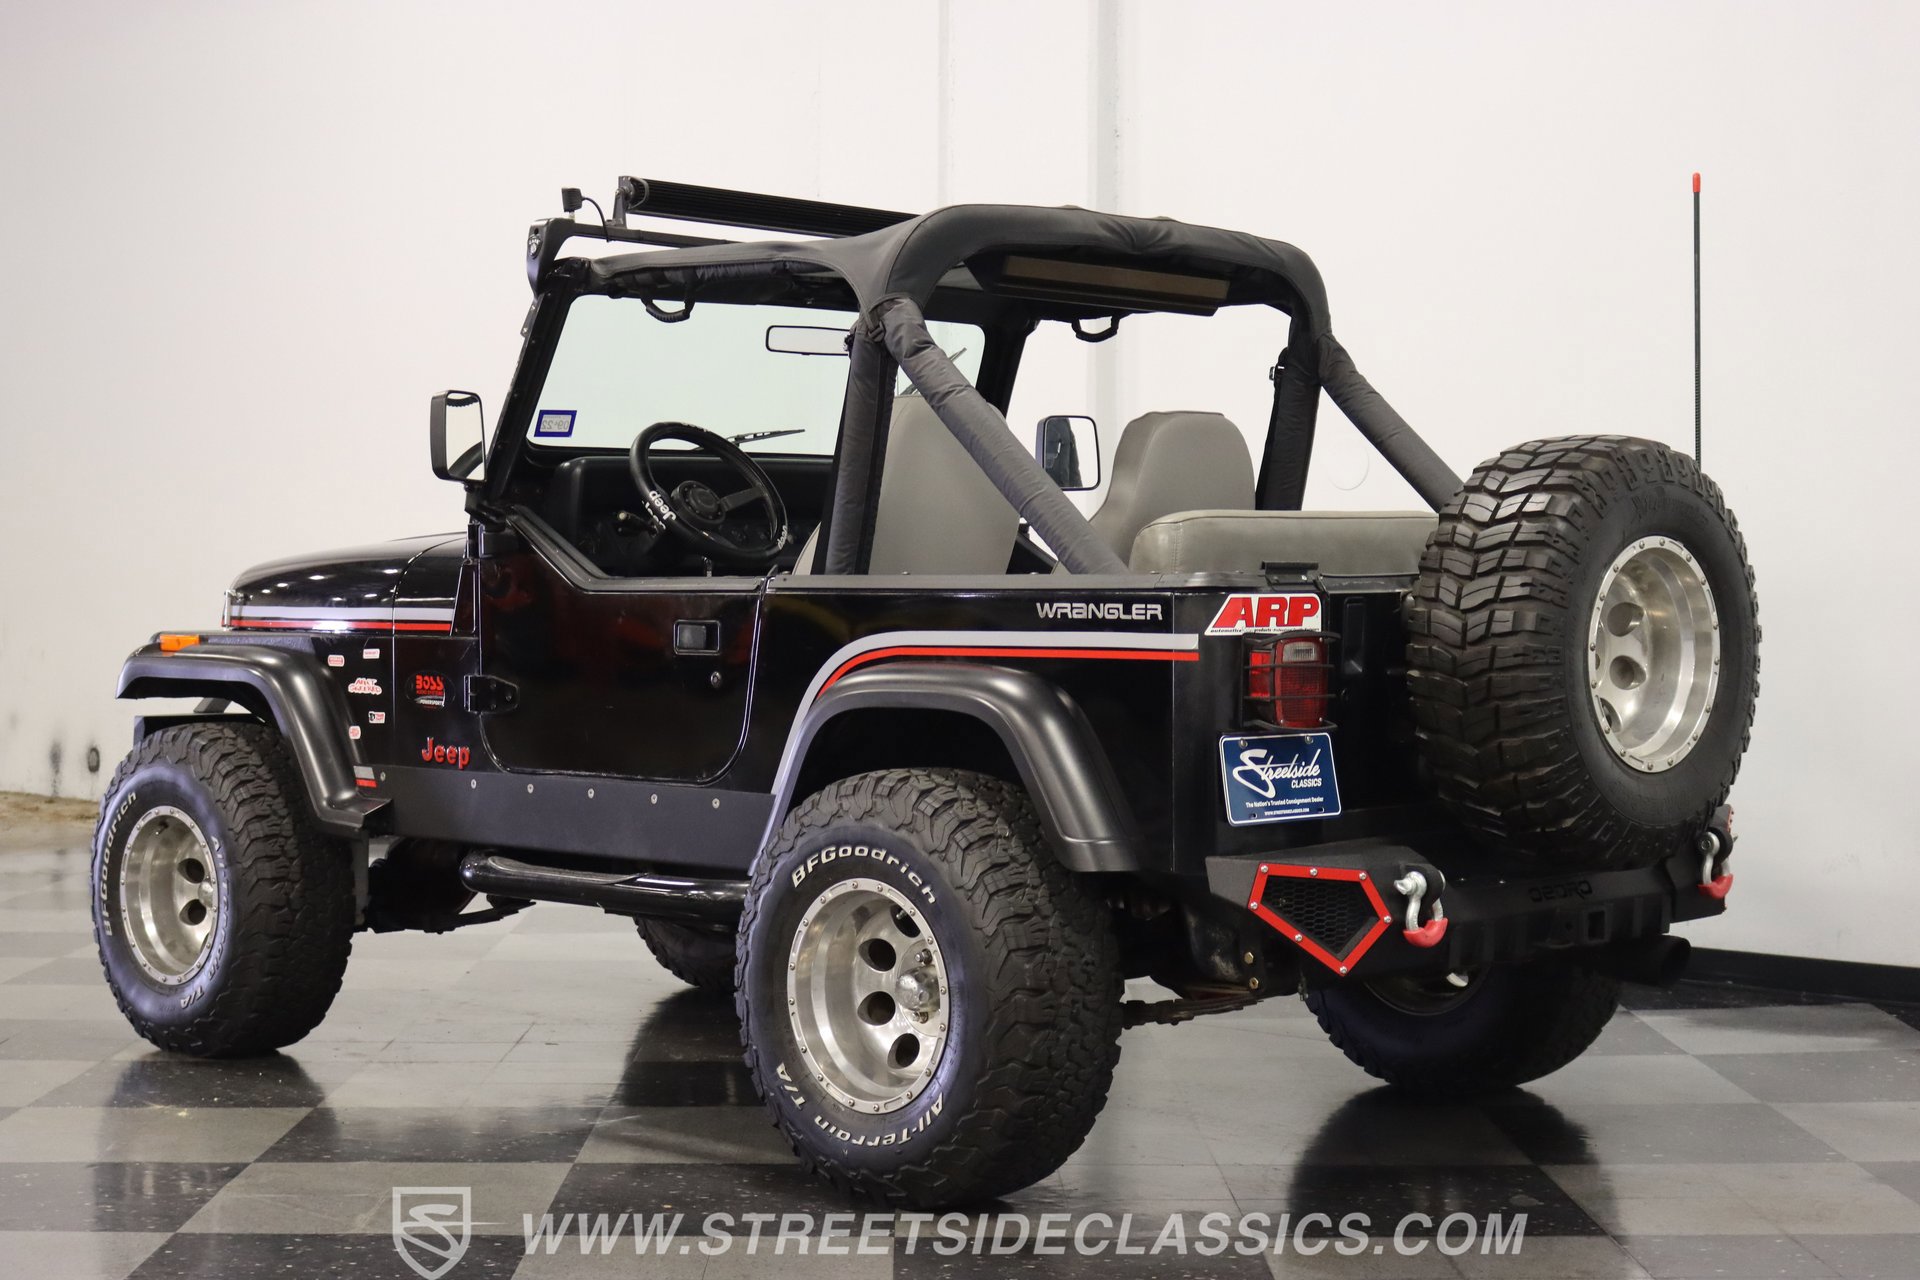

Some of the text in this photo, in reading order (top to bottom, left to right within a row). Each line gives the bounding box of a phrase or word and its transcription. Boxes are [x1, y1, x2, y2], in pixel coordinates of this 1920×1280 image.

[649, 490, 677, 521] Jeep
[1036, 602, 1163, 621] WRANGLER
[1212, 596, 1320, 628] ARP
[415, 674, 444, 691] BOSS
[421, 737, 471, 769] Jeep
[1232, 748, 1321, 799] Streetside
[1291, 777, 1322, 789] CLASSICS
[101, 791, 137, 936] BFGoodrich
[791, 845, 937, 904] BFGoodrich
[776, 1063, 944, 1147] All-Terrain T/A
